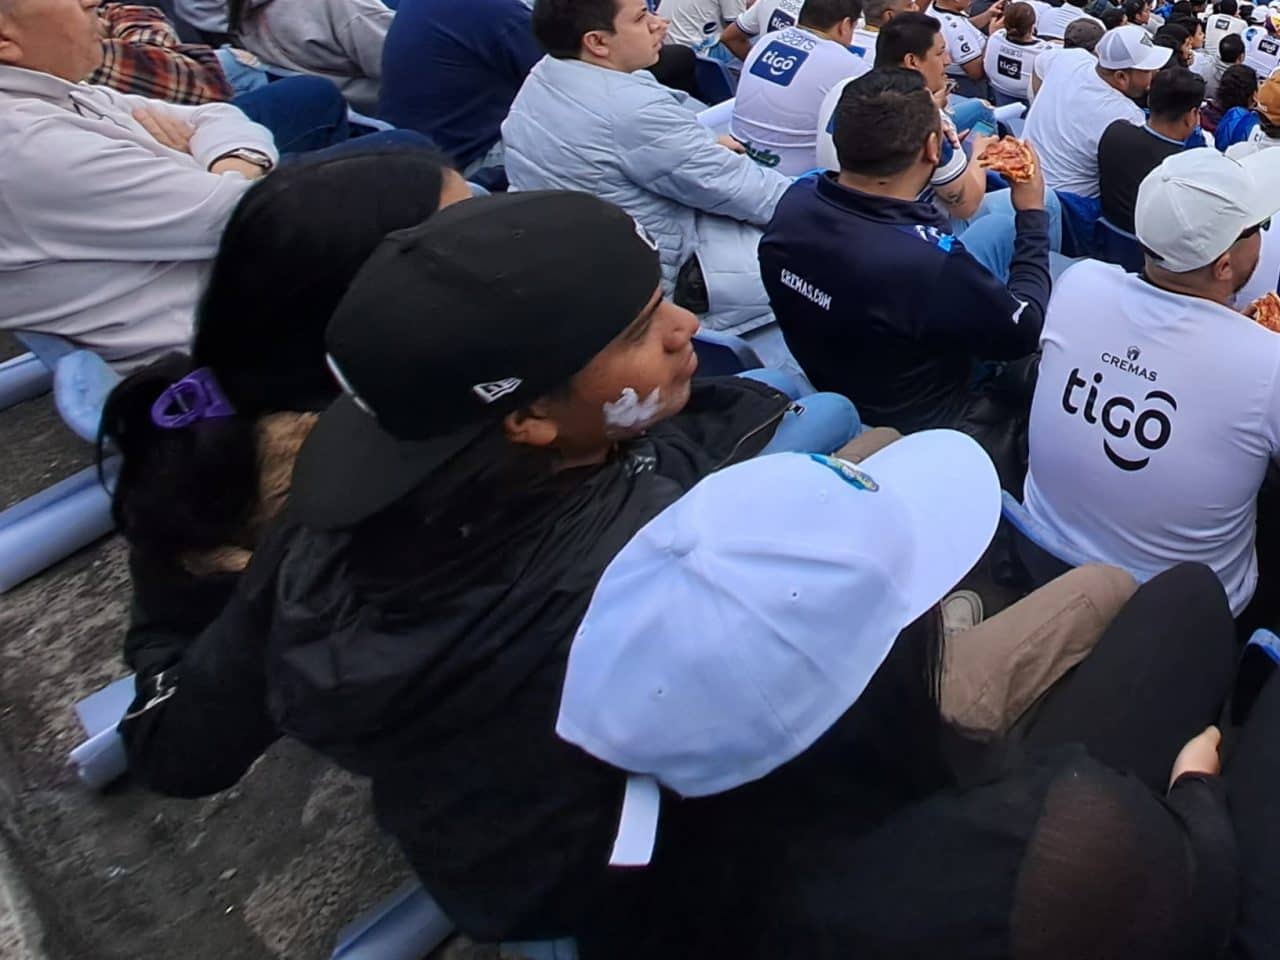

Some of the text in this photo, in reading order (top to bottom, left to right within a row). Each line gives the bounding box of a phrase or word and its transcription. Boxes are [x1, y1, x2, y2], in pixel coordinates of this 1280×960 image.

[762, 50, 798, 75] tigo
[999, 61, 1018, 75] tigo
[780, 268, 832, 311] CREMAS.COM
[1101, 352, 1158, 382] CREMAS
[1062, 368, 1177, 471] tigo
